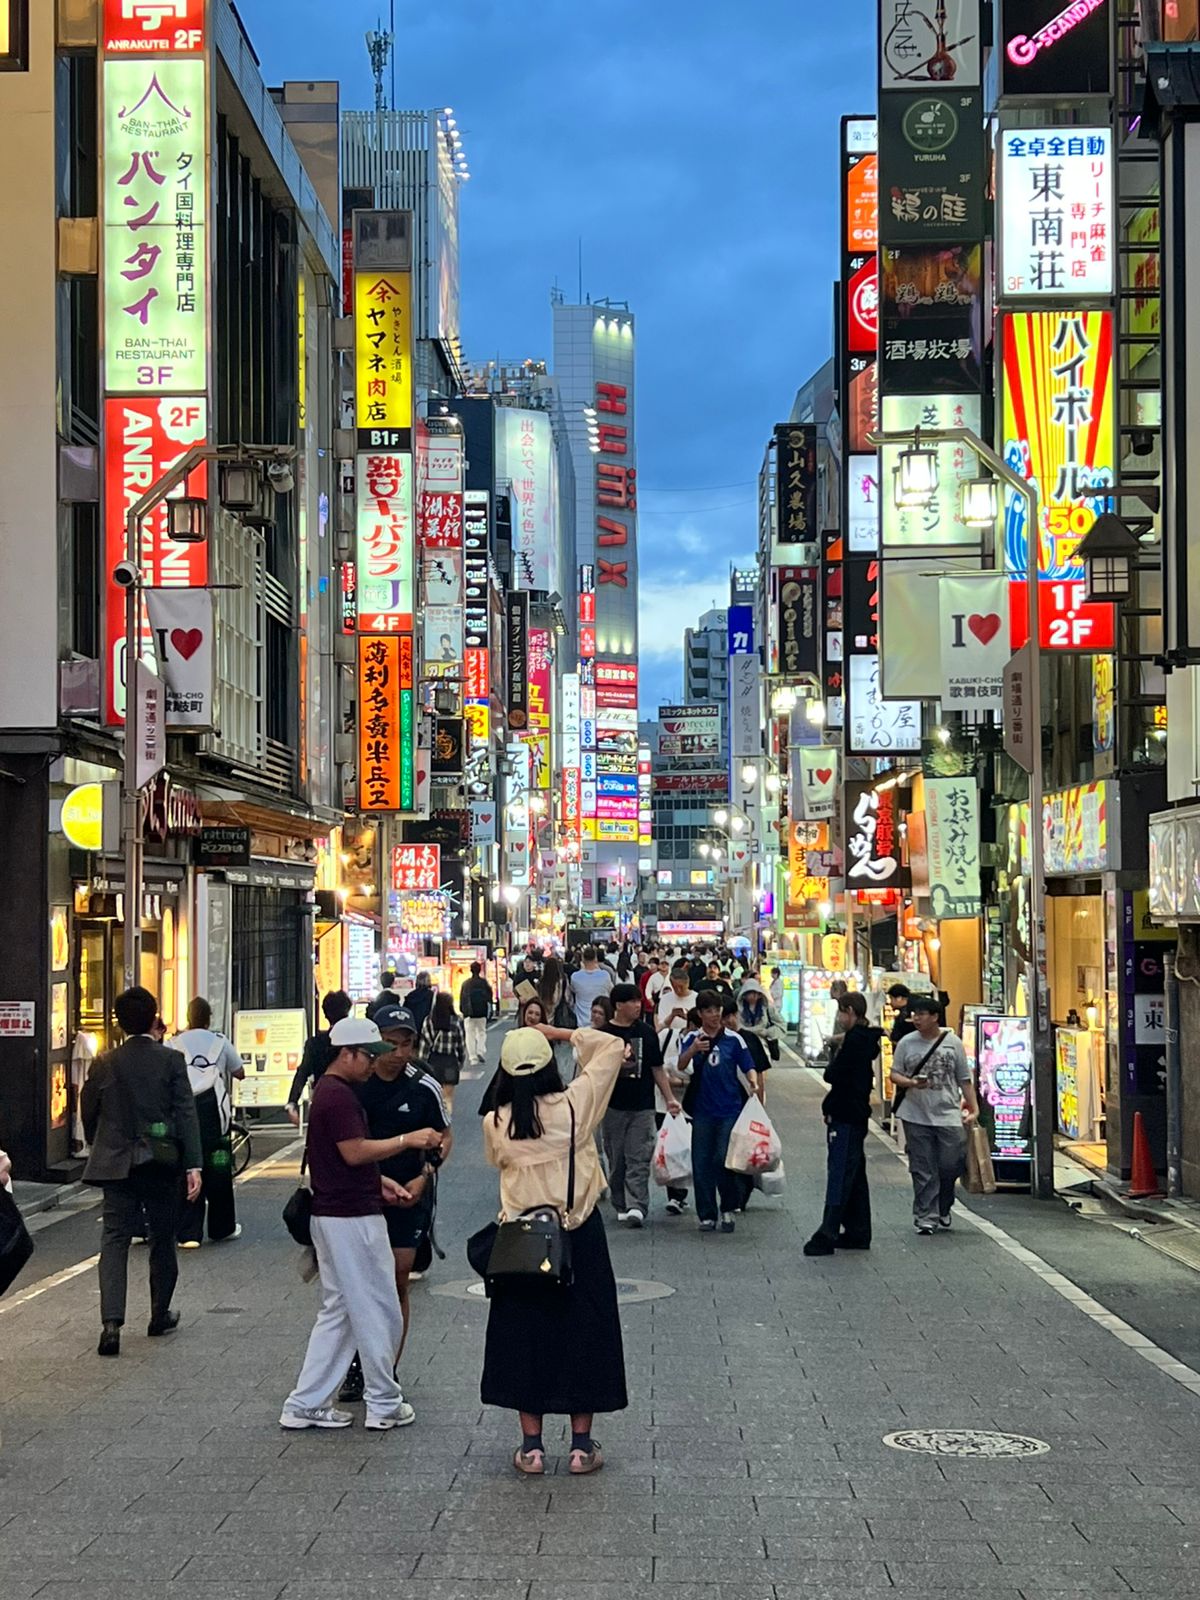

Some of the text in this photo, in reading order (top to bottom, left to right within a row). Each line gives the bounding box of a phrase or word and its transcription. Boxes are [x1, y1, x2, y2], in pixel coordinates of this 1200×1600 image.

[107, 29, 202, 50] ANRAKUTEI 2F
[960, 98, 972, 107] 3F
[120, 121, 189, 138] RESTAURANT
[129, 117, 180, 130] BAN-THAI
[1008, 136, 1105, 157] 全卓全自動
[914, 154, 946, 162] YURUHA
[960, 174, 971, 183] 3F
[1090, 161, 1106, 263] リーチ麻雀
[175, 152, 196, 313] タイ国料理専門店
[1028, 163, 1065, 290] 東南荘
[117, 150, 166, 325] バンタイ
[1070, 203, 1087, 278] 専門店
[850, 258, 864, 269] 4F
[888, 250, 900, 259] 2F
[1007, 277, 1025, 291] 3F
[125, 338, 187, 347] BAN-THAI
[391, 306, 402, 385] やきとん酒場
[885, 339, 972, 360] 酒場牧場
[115, 349, 195, 360] RESTAURANT
[850, 358, 867, 370] 3F
[366, 308, 388, 422] ヤマネ肉店
[137, 366, 173, 385] 3F
[170, 406, 200, 427] 2F
[1051, 318, 1093, 500] ハイボール
[370, 431, 399, 446] B1F
[371, 615, 400, 631] 4F
[951, 613, 967, 648] I
[1049, 619, 1093, 645] 2F
[156, 628, 169, 663] I
[949, 677, 1003, 685] KABUKI-CHO
[949, 686, 1003, 698] 歌舞伎町
[1011, 672, 1023, 744] 劇場通り一番街
[806, 768, 816, 787] I
[766, 820, 772, 834] I
[943, 787, 977, 885] お好み焼き
[955, 902, 982, 914] B1F
[1125, 906, 1132, 924] 5F
[1126, 958, 1133, 976] 4F
[1127, 1009, 1133, 1028] 3F
[1143, 1009, 1164, 1030] 東
